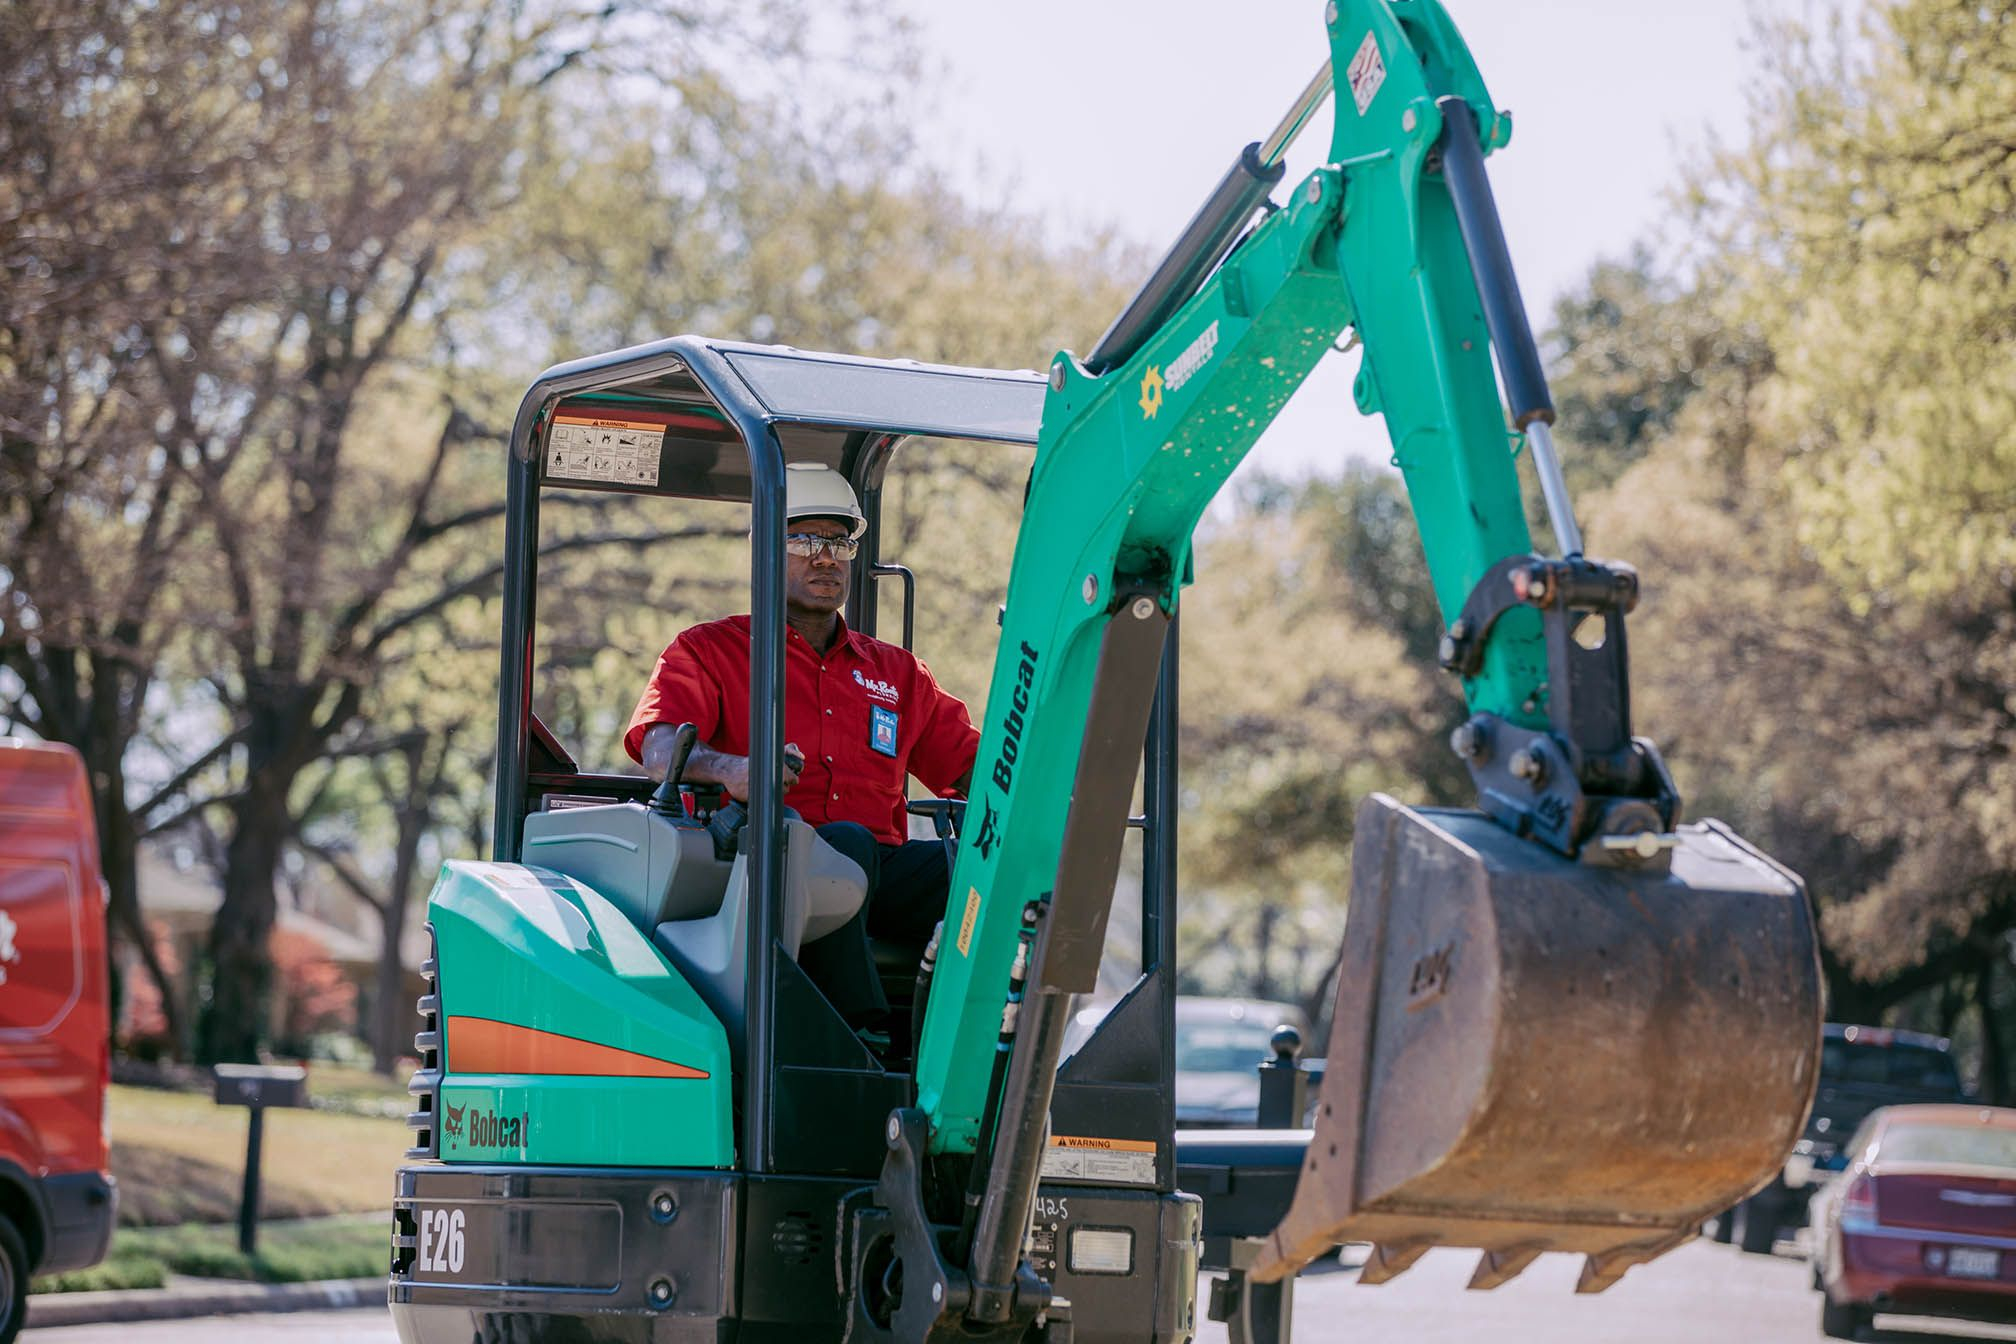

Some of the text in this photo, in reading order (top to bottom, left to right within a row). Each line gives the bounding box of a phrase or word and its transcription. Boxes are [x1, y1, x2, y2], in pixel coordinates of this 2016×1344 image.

[992, 640, 1039, 796] Bobcat
[469, 1108, 529, 1148] Bobcat
[1069, 1138, 1111, 1149] WARNING
[420, 1208, 466, 1273] E26
